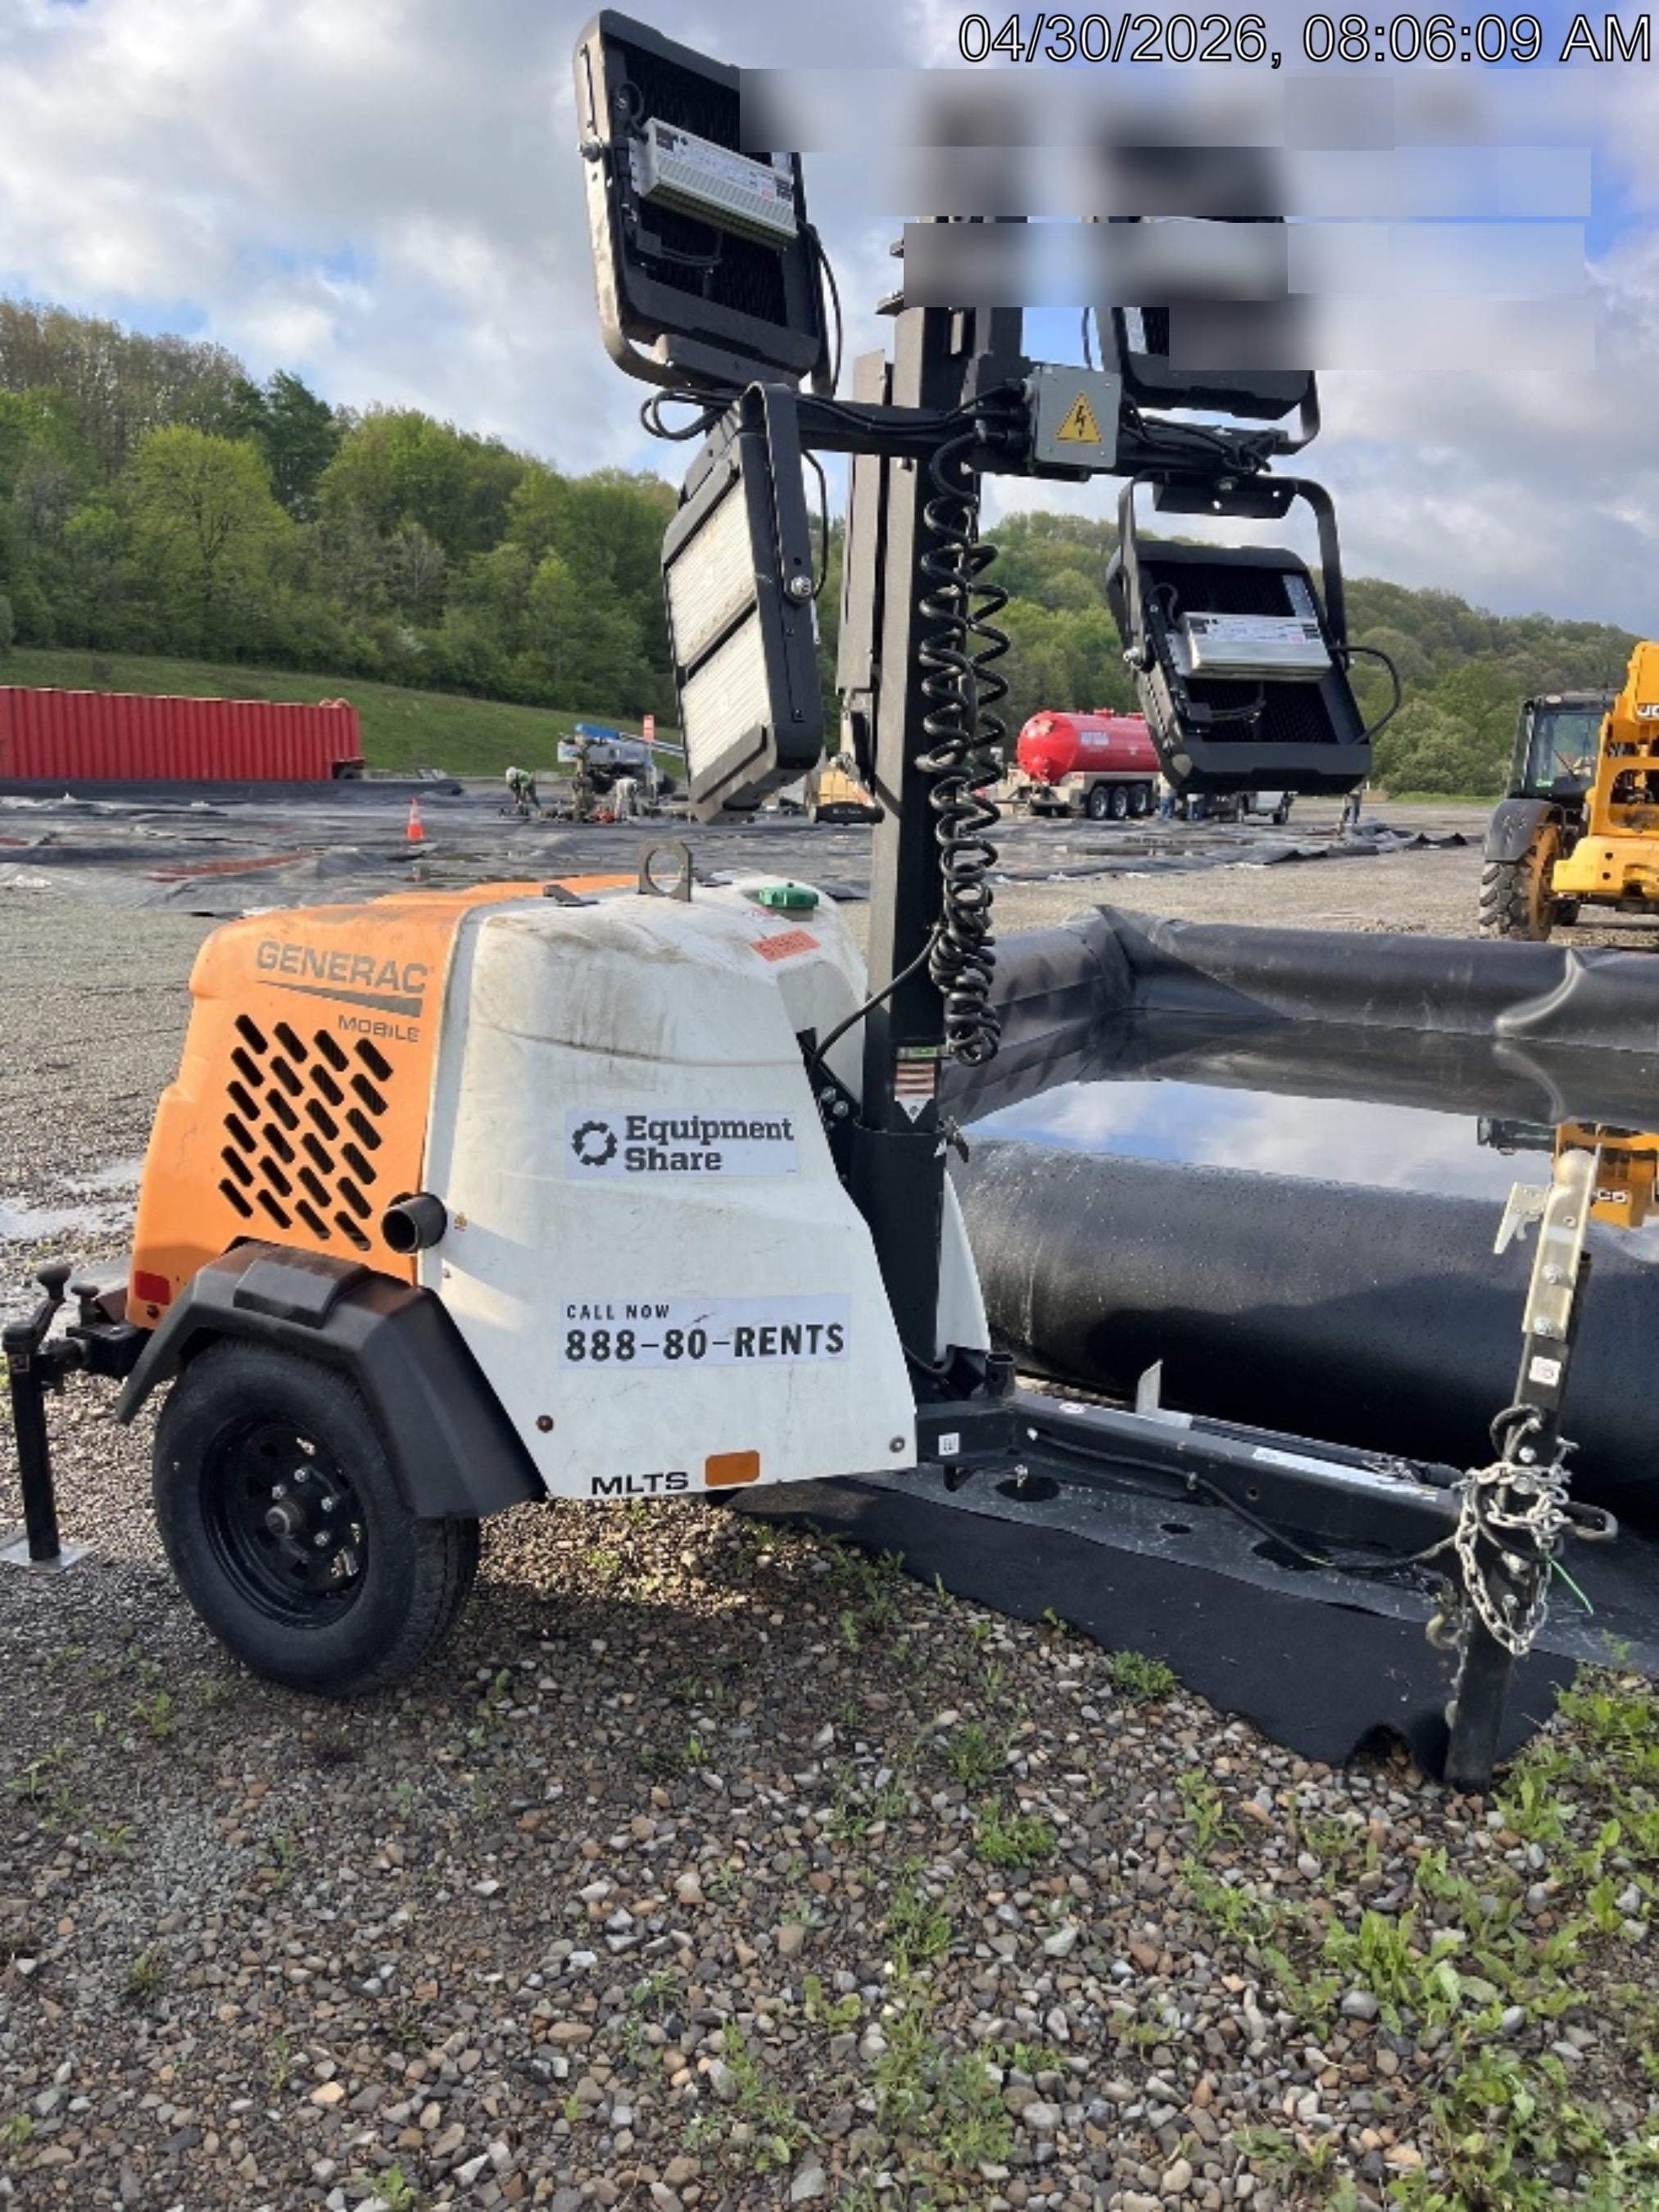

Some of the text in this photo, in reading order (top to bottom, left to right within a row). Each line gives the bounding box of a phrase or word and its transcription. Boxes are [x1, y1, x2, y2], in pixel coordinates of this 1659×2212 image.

[256, 941, 428, 994] GENERAC
[338, 1014, 420, 1043] MOBILE
[625, 1115, 795, 1145] Equipment
[625, 1147, 723, 1172] Share
[567, 1304, 670, 1321] CALL NOW
[565, 1322, 844, 1362] 888-80-RENTS
[592, 1471, 689, 1495] MLTS
